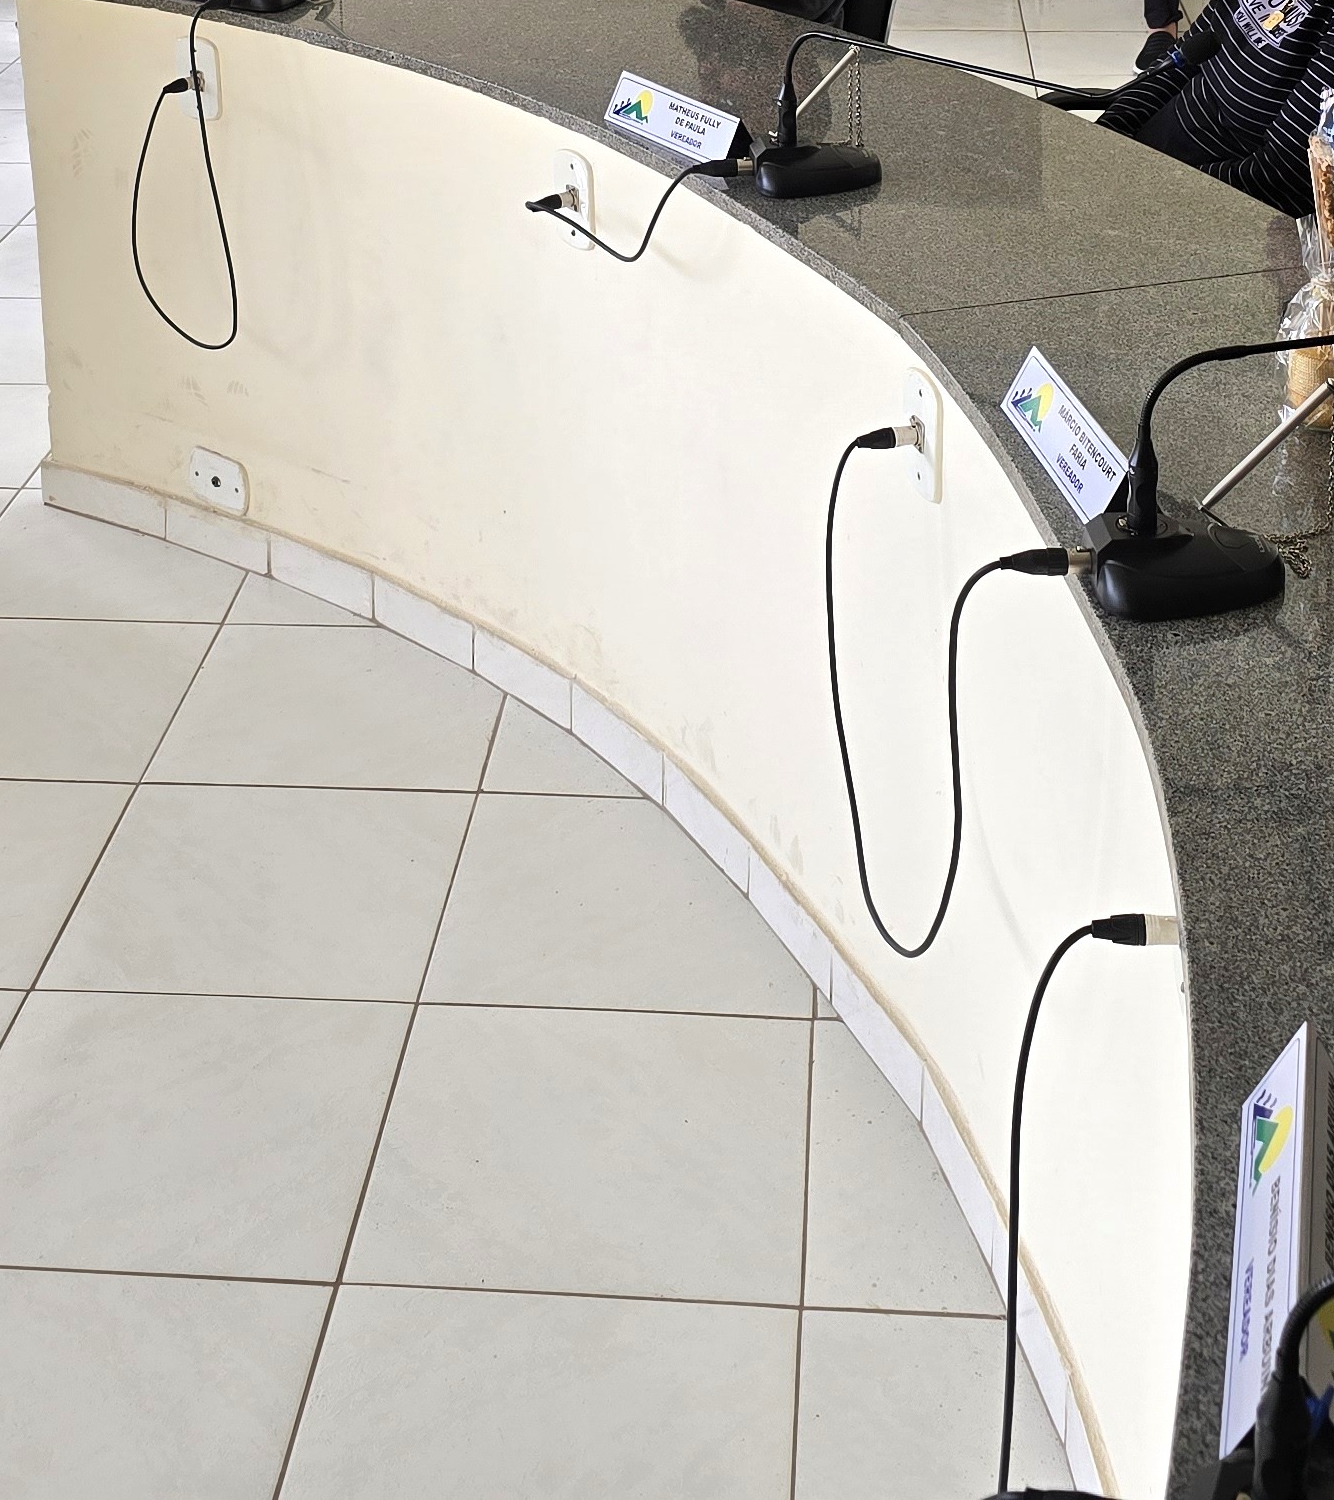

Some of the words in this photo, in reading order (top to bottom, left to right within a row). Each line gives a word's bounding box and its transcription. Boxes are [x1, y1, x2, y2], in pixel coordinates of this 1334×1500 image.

[669, 102, 700, 120] MATHEUS
[700, 115, 721, 129] FULLY
[675, 117, 685, 126] DE
[685, 121, 706, 135] PAULA
[670, 130, 702, 149] VEREADOR
[1058, 405, 1081, 436] MÁRCIO
[1079, 431, 1116, 482] BITENCOURT
[1069, 444, 1087, 470] FARIA
[1056, 453, 1084, 494] VEREADOR
[1268, 1175, 1281, 1255] BENÍSIO
[1264, 1256, 1276, 1308] DIAS
[1239, 1257, 1254, 1363] VEREADOR
[1260, 1309, 1273, 1394] ARBUIN
